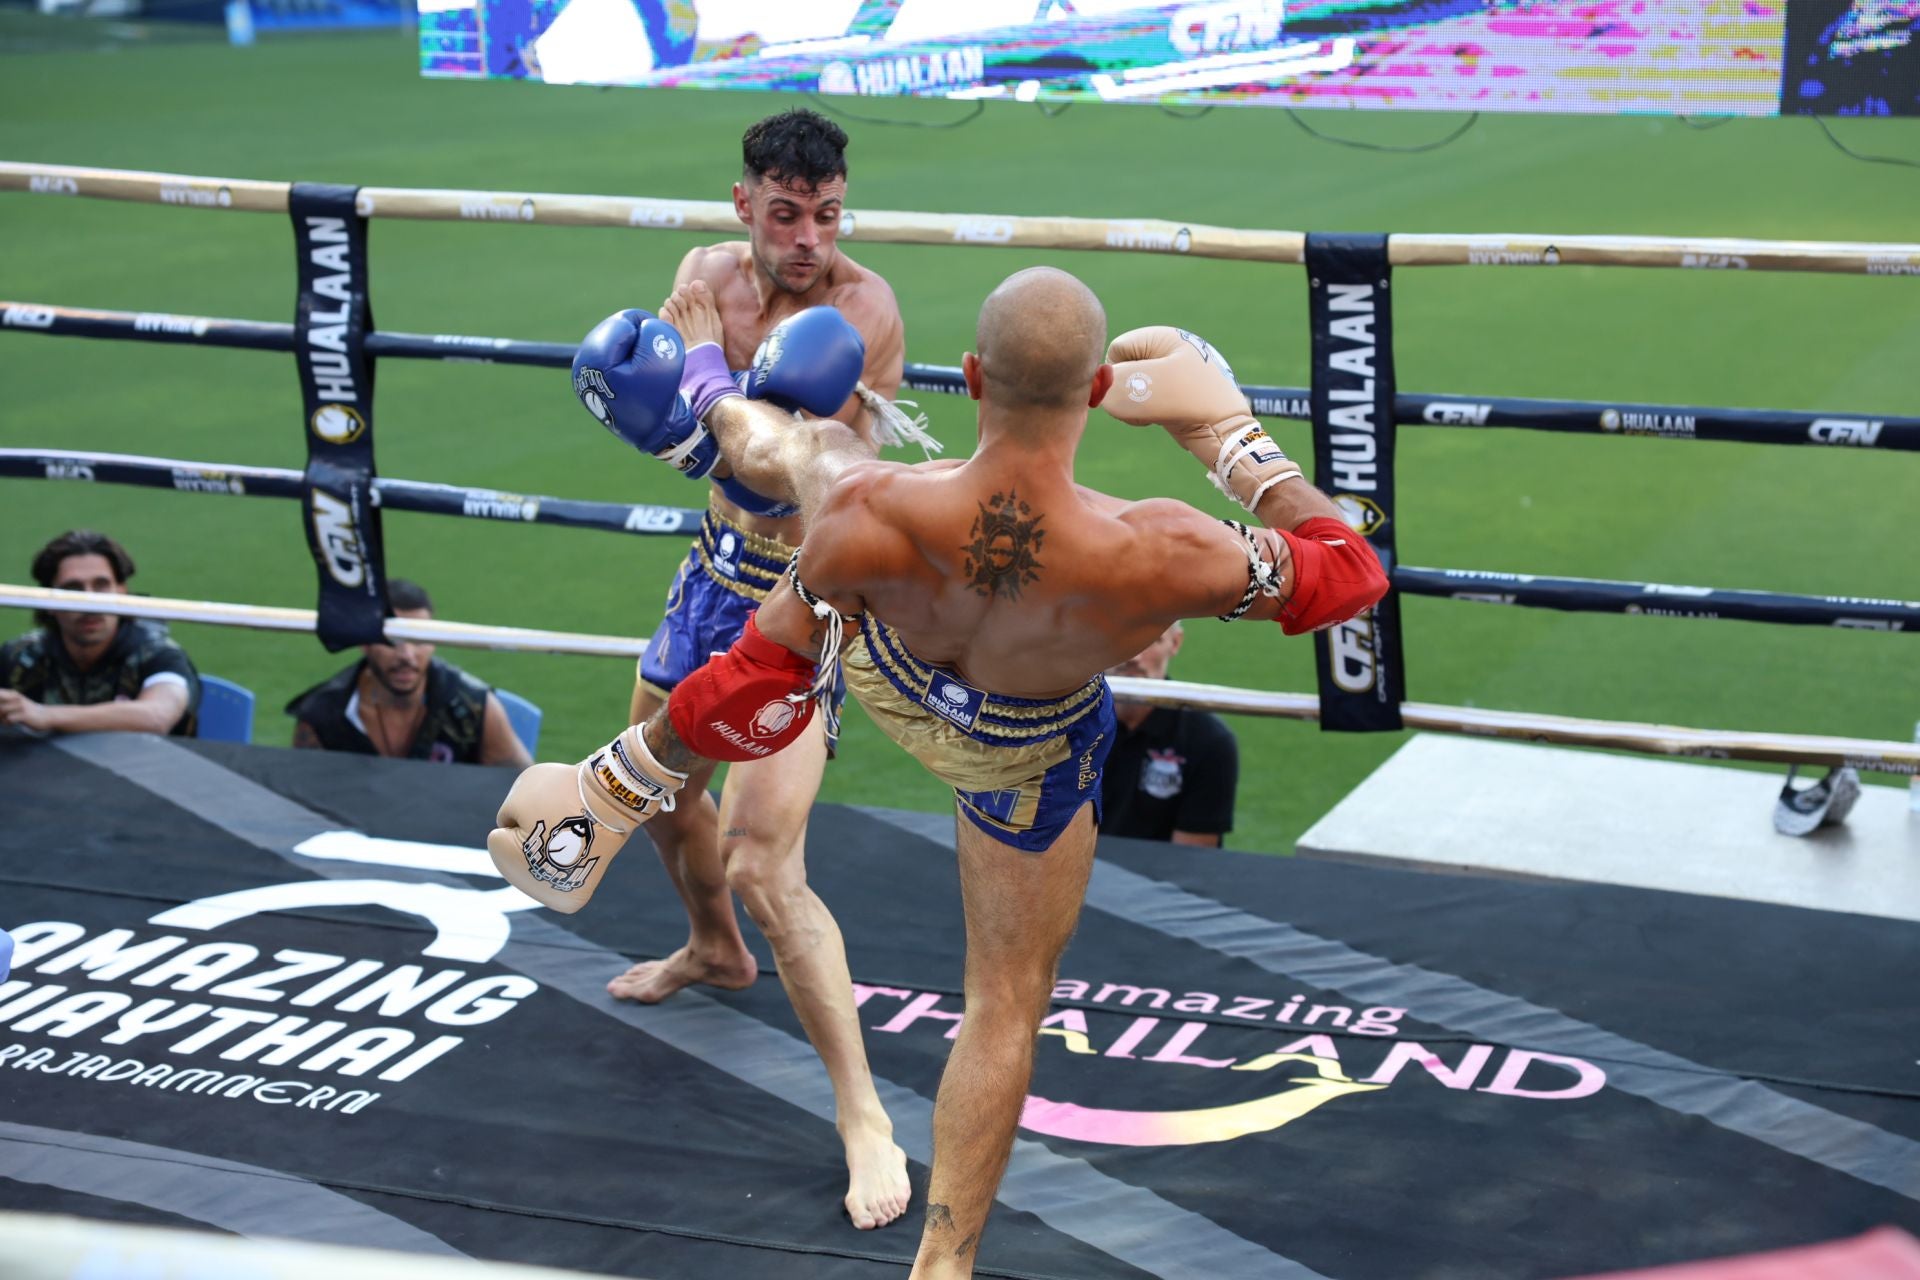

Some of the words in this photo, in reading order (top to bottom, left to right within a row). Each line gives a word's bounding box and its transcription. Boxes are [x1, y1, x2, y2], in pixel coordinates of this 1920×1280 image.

[857, 47, 983, 95] HUALAAN
[305, 216, 357, 401] HUALAAN
[1253, 399, 1311, 417] HUALAA
[1327, 284, 1377, 490] HUALAAN
[1423, 402, 1493, 426] CFN
[1622, 413, 1696, 433] HUALAAN
[1807, 418, 1885, 446] CFN
[312, 488, 364, 588] CFN
[625, 505, 684, 532] CFN
[928, 694, 973, 723] HUALAAN
[708, 720, 773, 755] HUALAAN
[7, 921, 538, 1026] AMAZING
[1051, 979, 1407, 1038] amazing
[852, 983, 1607, 1100] THAILAND
[0, 1043, 381, 1115] RAJADAMNERN
